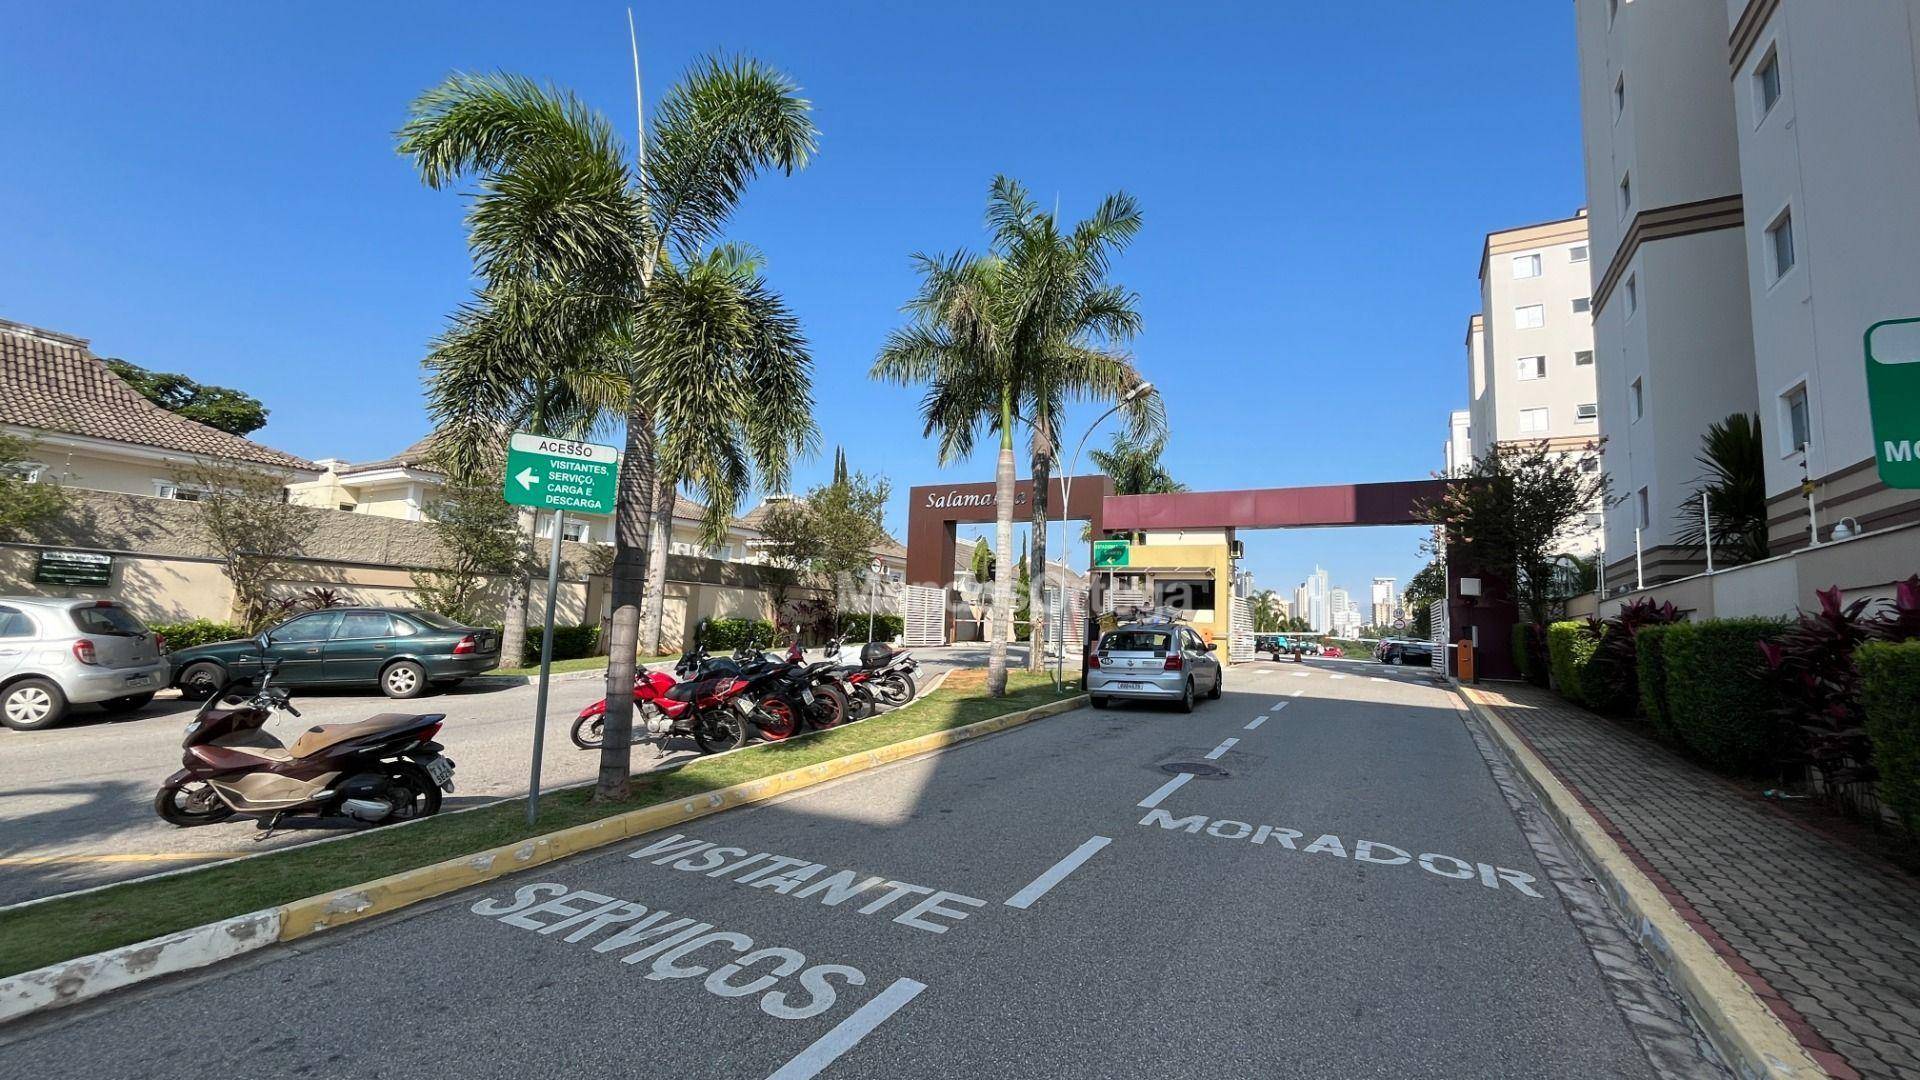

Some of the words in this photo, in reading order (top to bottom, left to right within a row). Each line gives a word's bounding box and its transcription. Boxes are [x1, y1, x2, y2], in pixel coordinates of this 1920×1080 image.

[539, 441, 592, 457] ACESSO
[550, 460, 609, 476] VISITANTES,
[549, 472, 595, 486] SERVIÇO,
[547, 484, 583, 495] CARGA
[585, 488, 593, 496] E
[546, 495, 602, 508] DESCARGA
[925, 490, 1026, 508] Salamaa
[1138, 809, 1544, 898] MORADOR
[628, 834, 988, 933] VISITANTE
[471, 882, 866, 1019] SERVIÇOS
